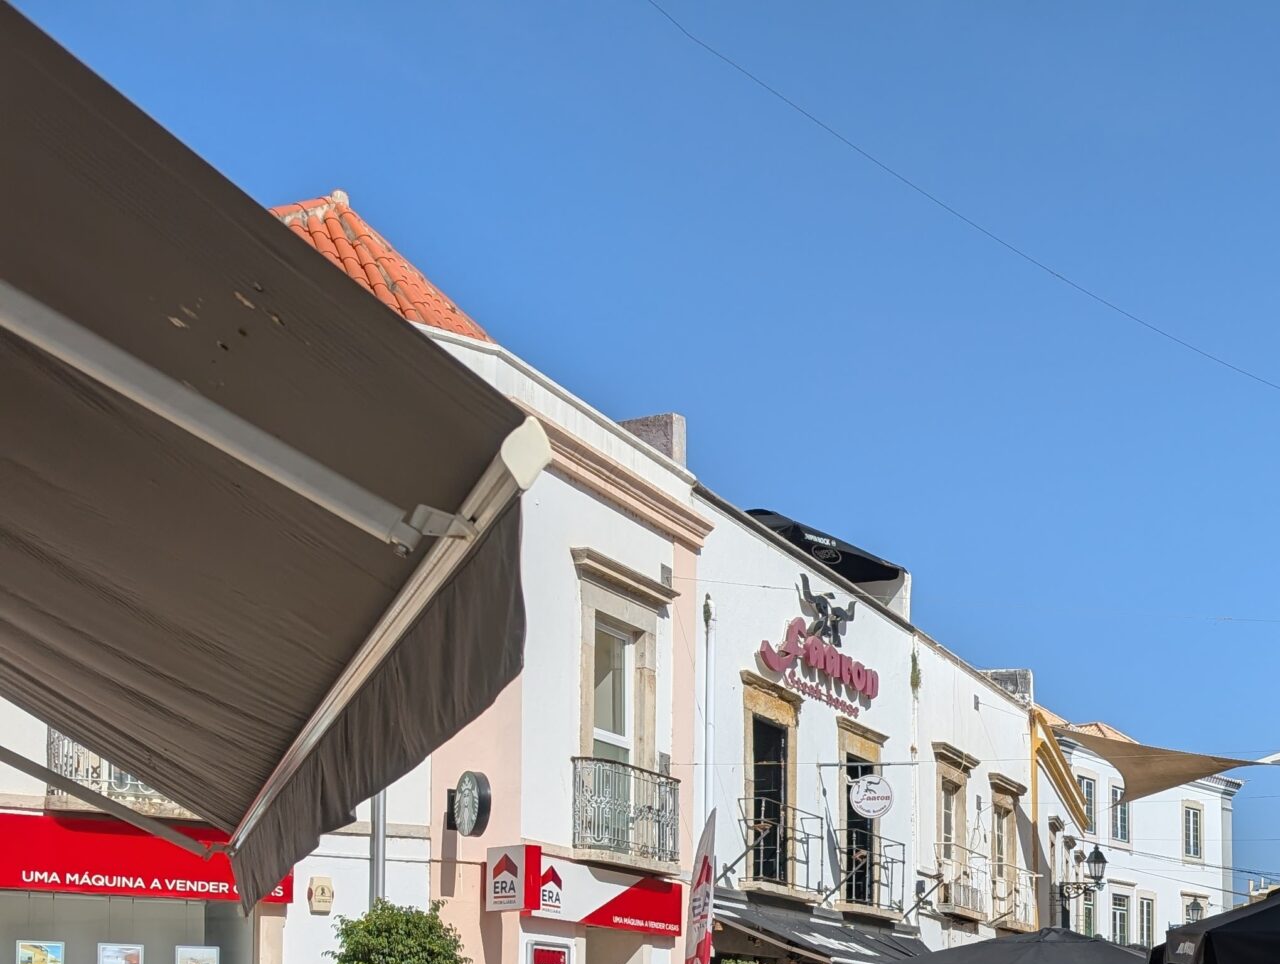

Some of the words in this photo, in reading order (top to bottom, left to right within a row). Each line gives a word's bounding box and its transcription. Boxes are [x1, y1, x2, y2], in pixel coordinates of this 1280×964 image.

[21, 870, 60, 884] UMA
[65, 871, 146, 889] MÁQUINA
[150, 878, 162, 890] A
[165, 879, 229, 894] VENDER
[493, 880, 516, 894] ERA
[542, 889, 561, 904] ERA
